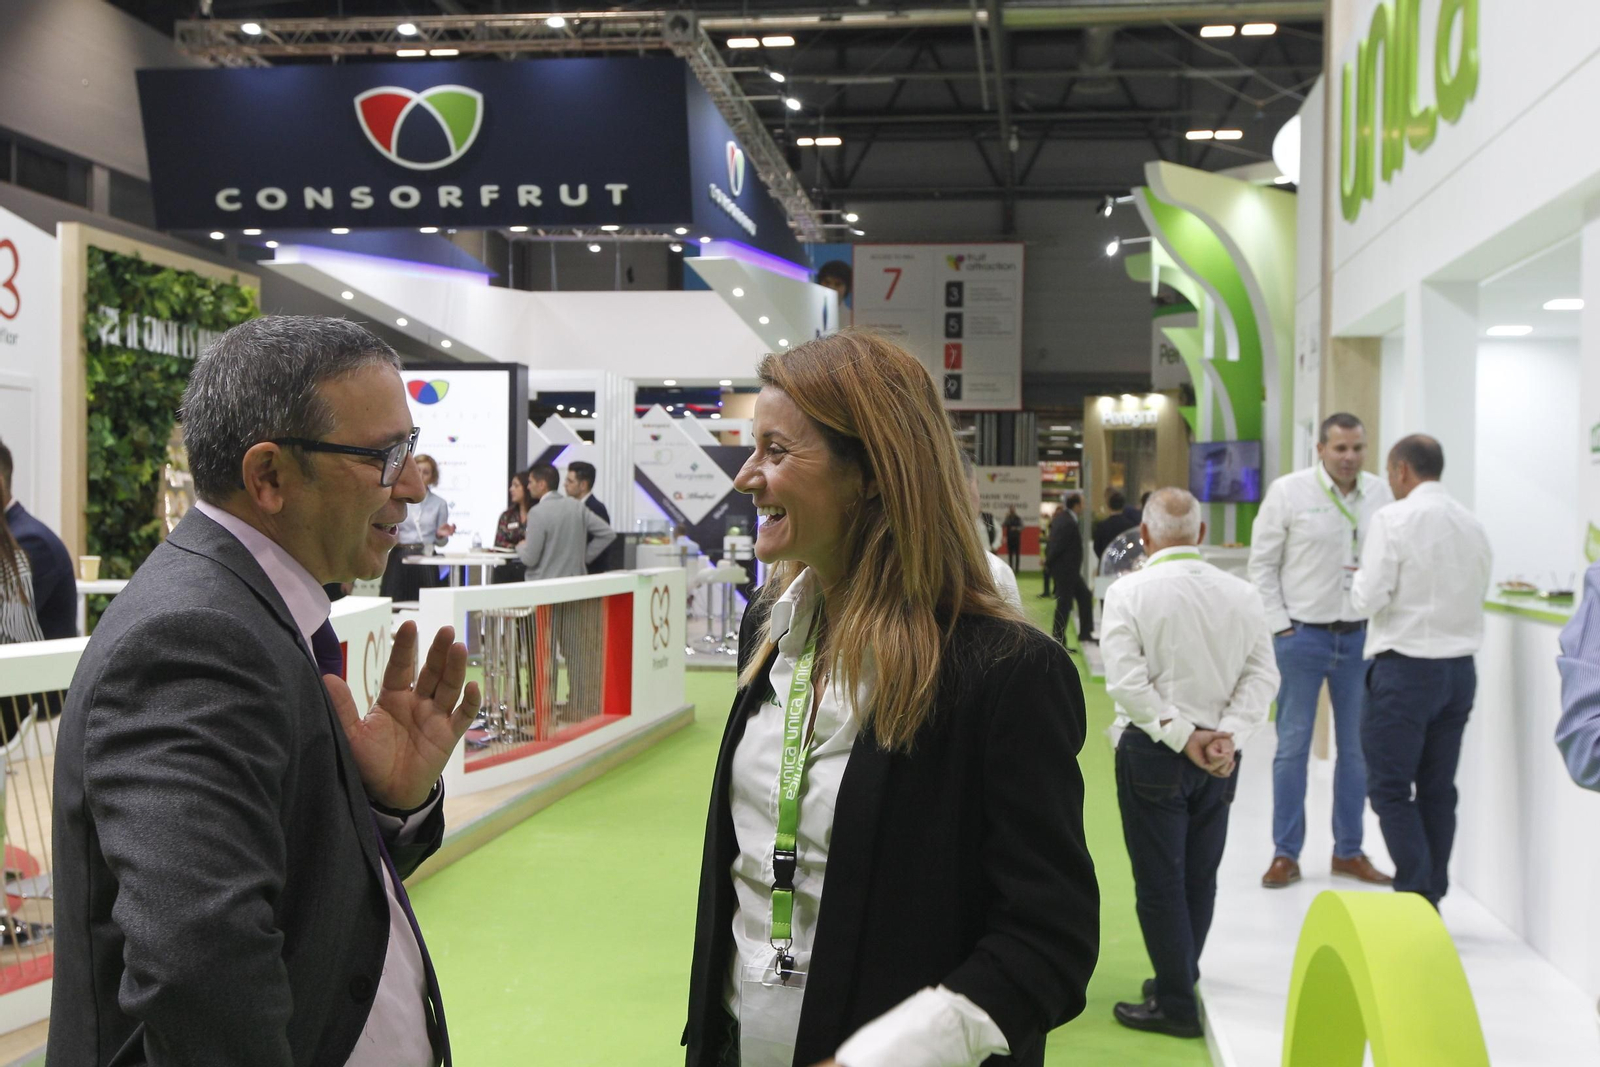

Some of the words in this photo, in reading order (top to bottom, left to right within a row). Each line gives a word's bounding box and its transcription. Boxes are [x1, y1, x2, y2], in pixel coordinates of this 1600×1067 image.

[215, 183, 629, 212] CONSORFRUT
[883, 267, 902, 301] 7
[949, 287, 959, 302] 3
[949, 317, 959, 333] 5
[794, 653, 812, 692] unica
[787, 698, 802, 740] unica
